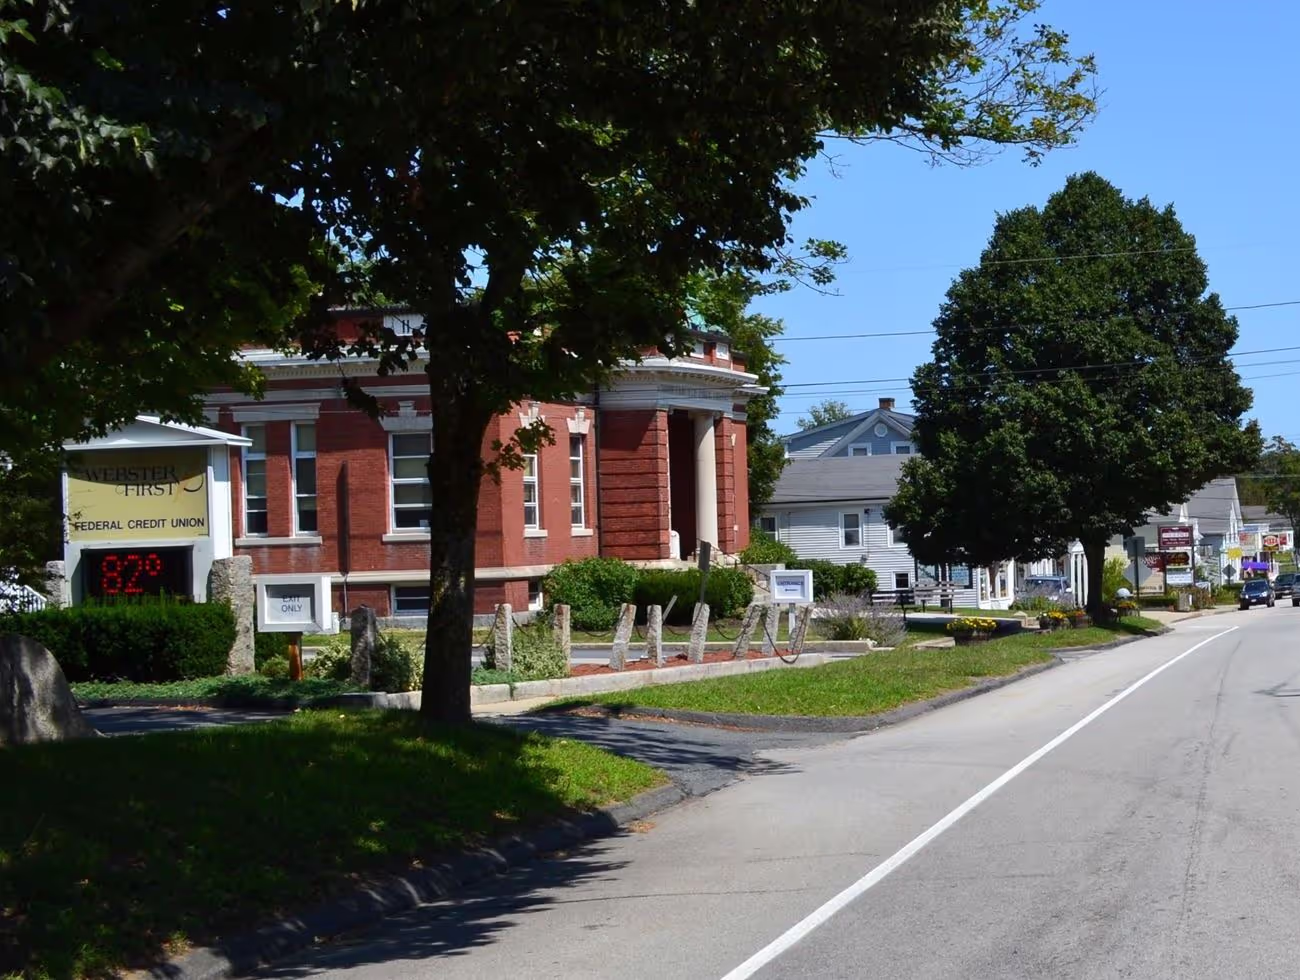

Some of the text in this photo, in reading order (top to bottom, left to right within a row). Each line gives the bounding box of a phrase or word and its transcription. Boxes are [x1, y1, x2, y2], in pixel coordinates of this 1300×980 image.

[84, 465, 180, 484] WEBSTER
[124, 481, 177, 497] FIRST
[75, 517, 205, 531] FEDERAL CREDIT UNION
[282, 595, 301, 603] EXIT
[281, 604, 303, 613] ONLY
